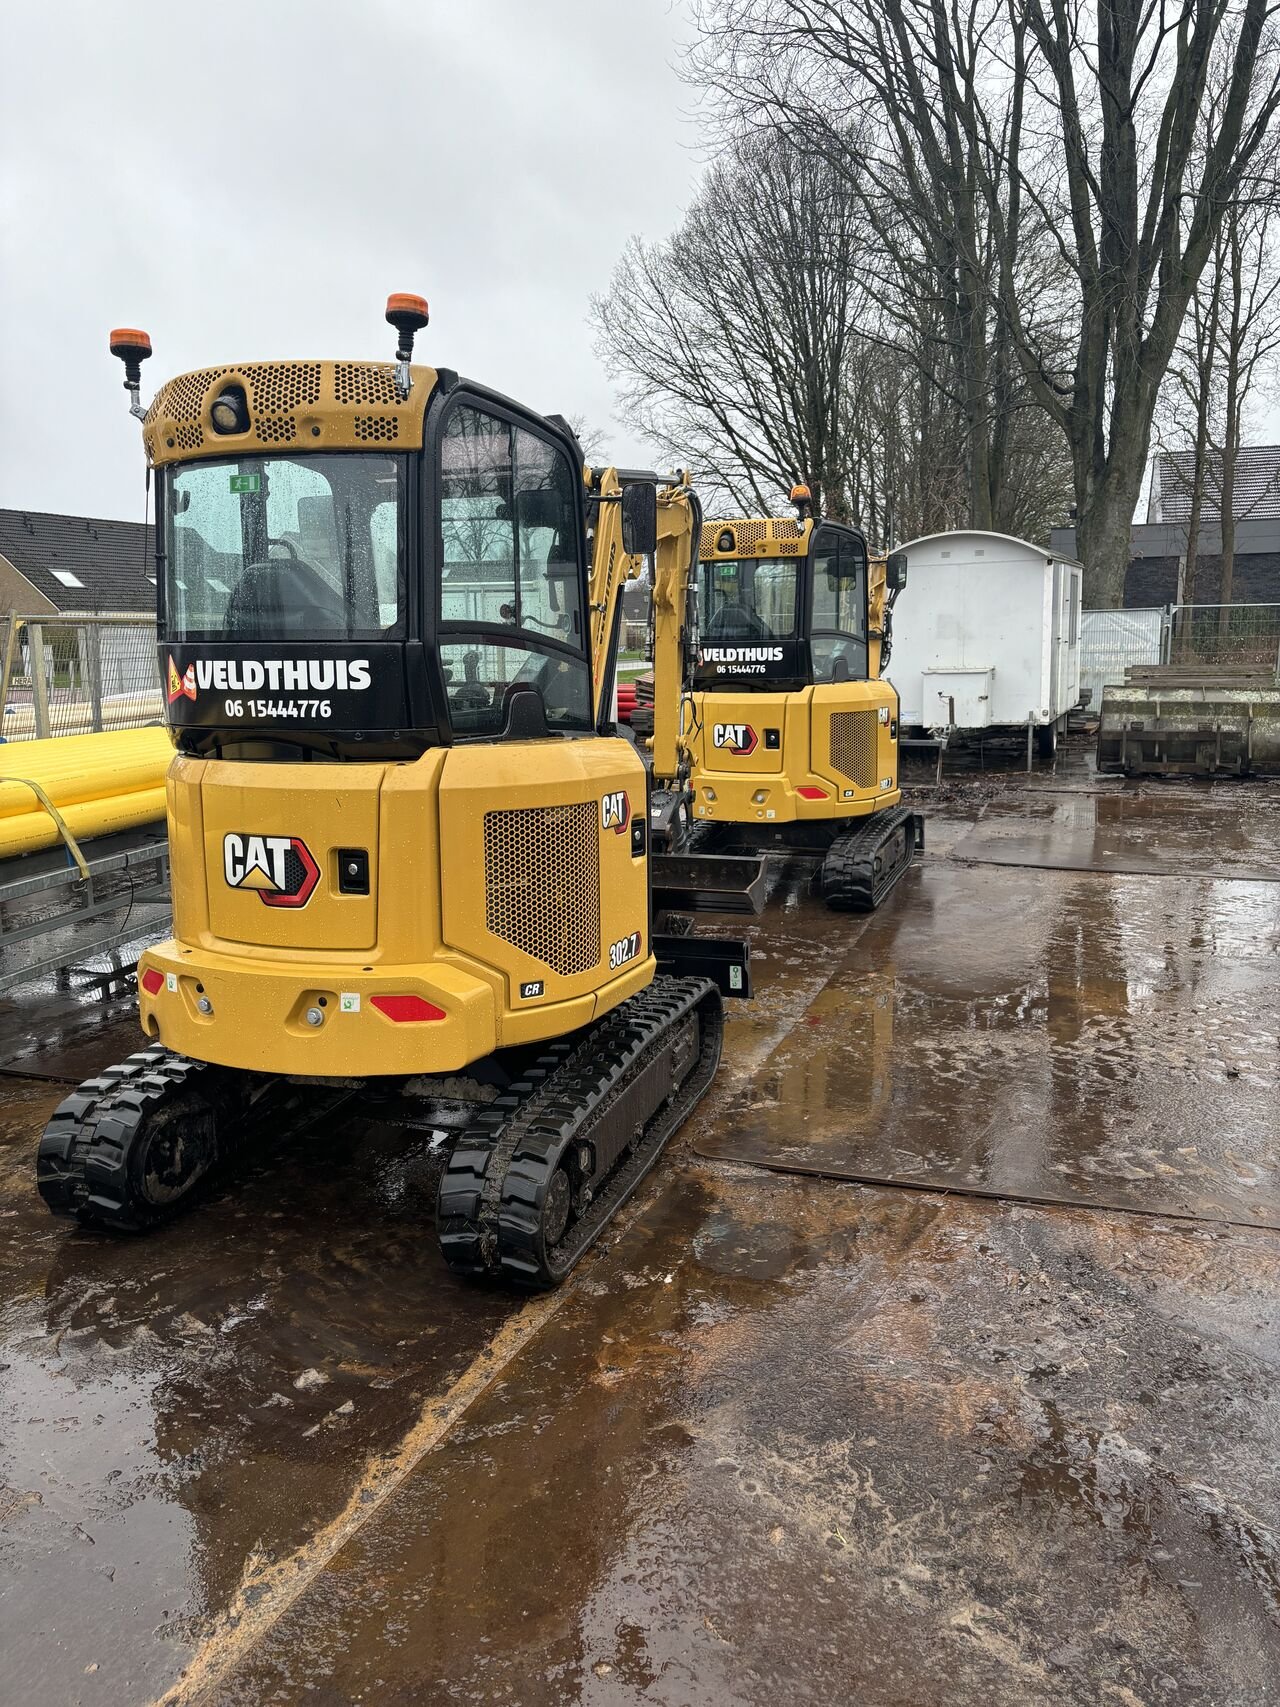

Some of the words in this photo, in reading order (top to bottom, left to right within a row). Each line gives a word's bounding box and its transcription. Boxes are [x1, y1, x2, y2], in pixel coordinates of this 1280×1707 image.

[703, 647, 784, 662] VELDTHUIS
[196, 659, 372, 691] VELDTHUIS
[716, 665, 726, 674] 06
[727, 664, 766, 674] 15444776
[225, 699, 243, 718] 06
[247, 699, 332, 718] 15444776
[879, 706, 889, 724] CAT
[713, 724, 746, 749] CAT
[602, 791, 625, 829] CAT
[223, 833, 291, 891] CAT
[609, 933, 637, 970] 302.7
[524, 983, 540, 996] CR
